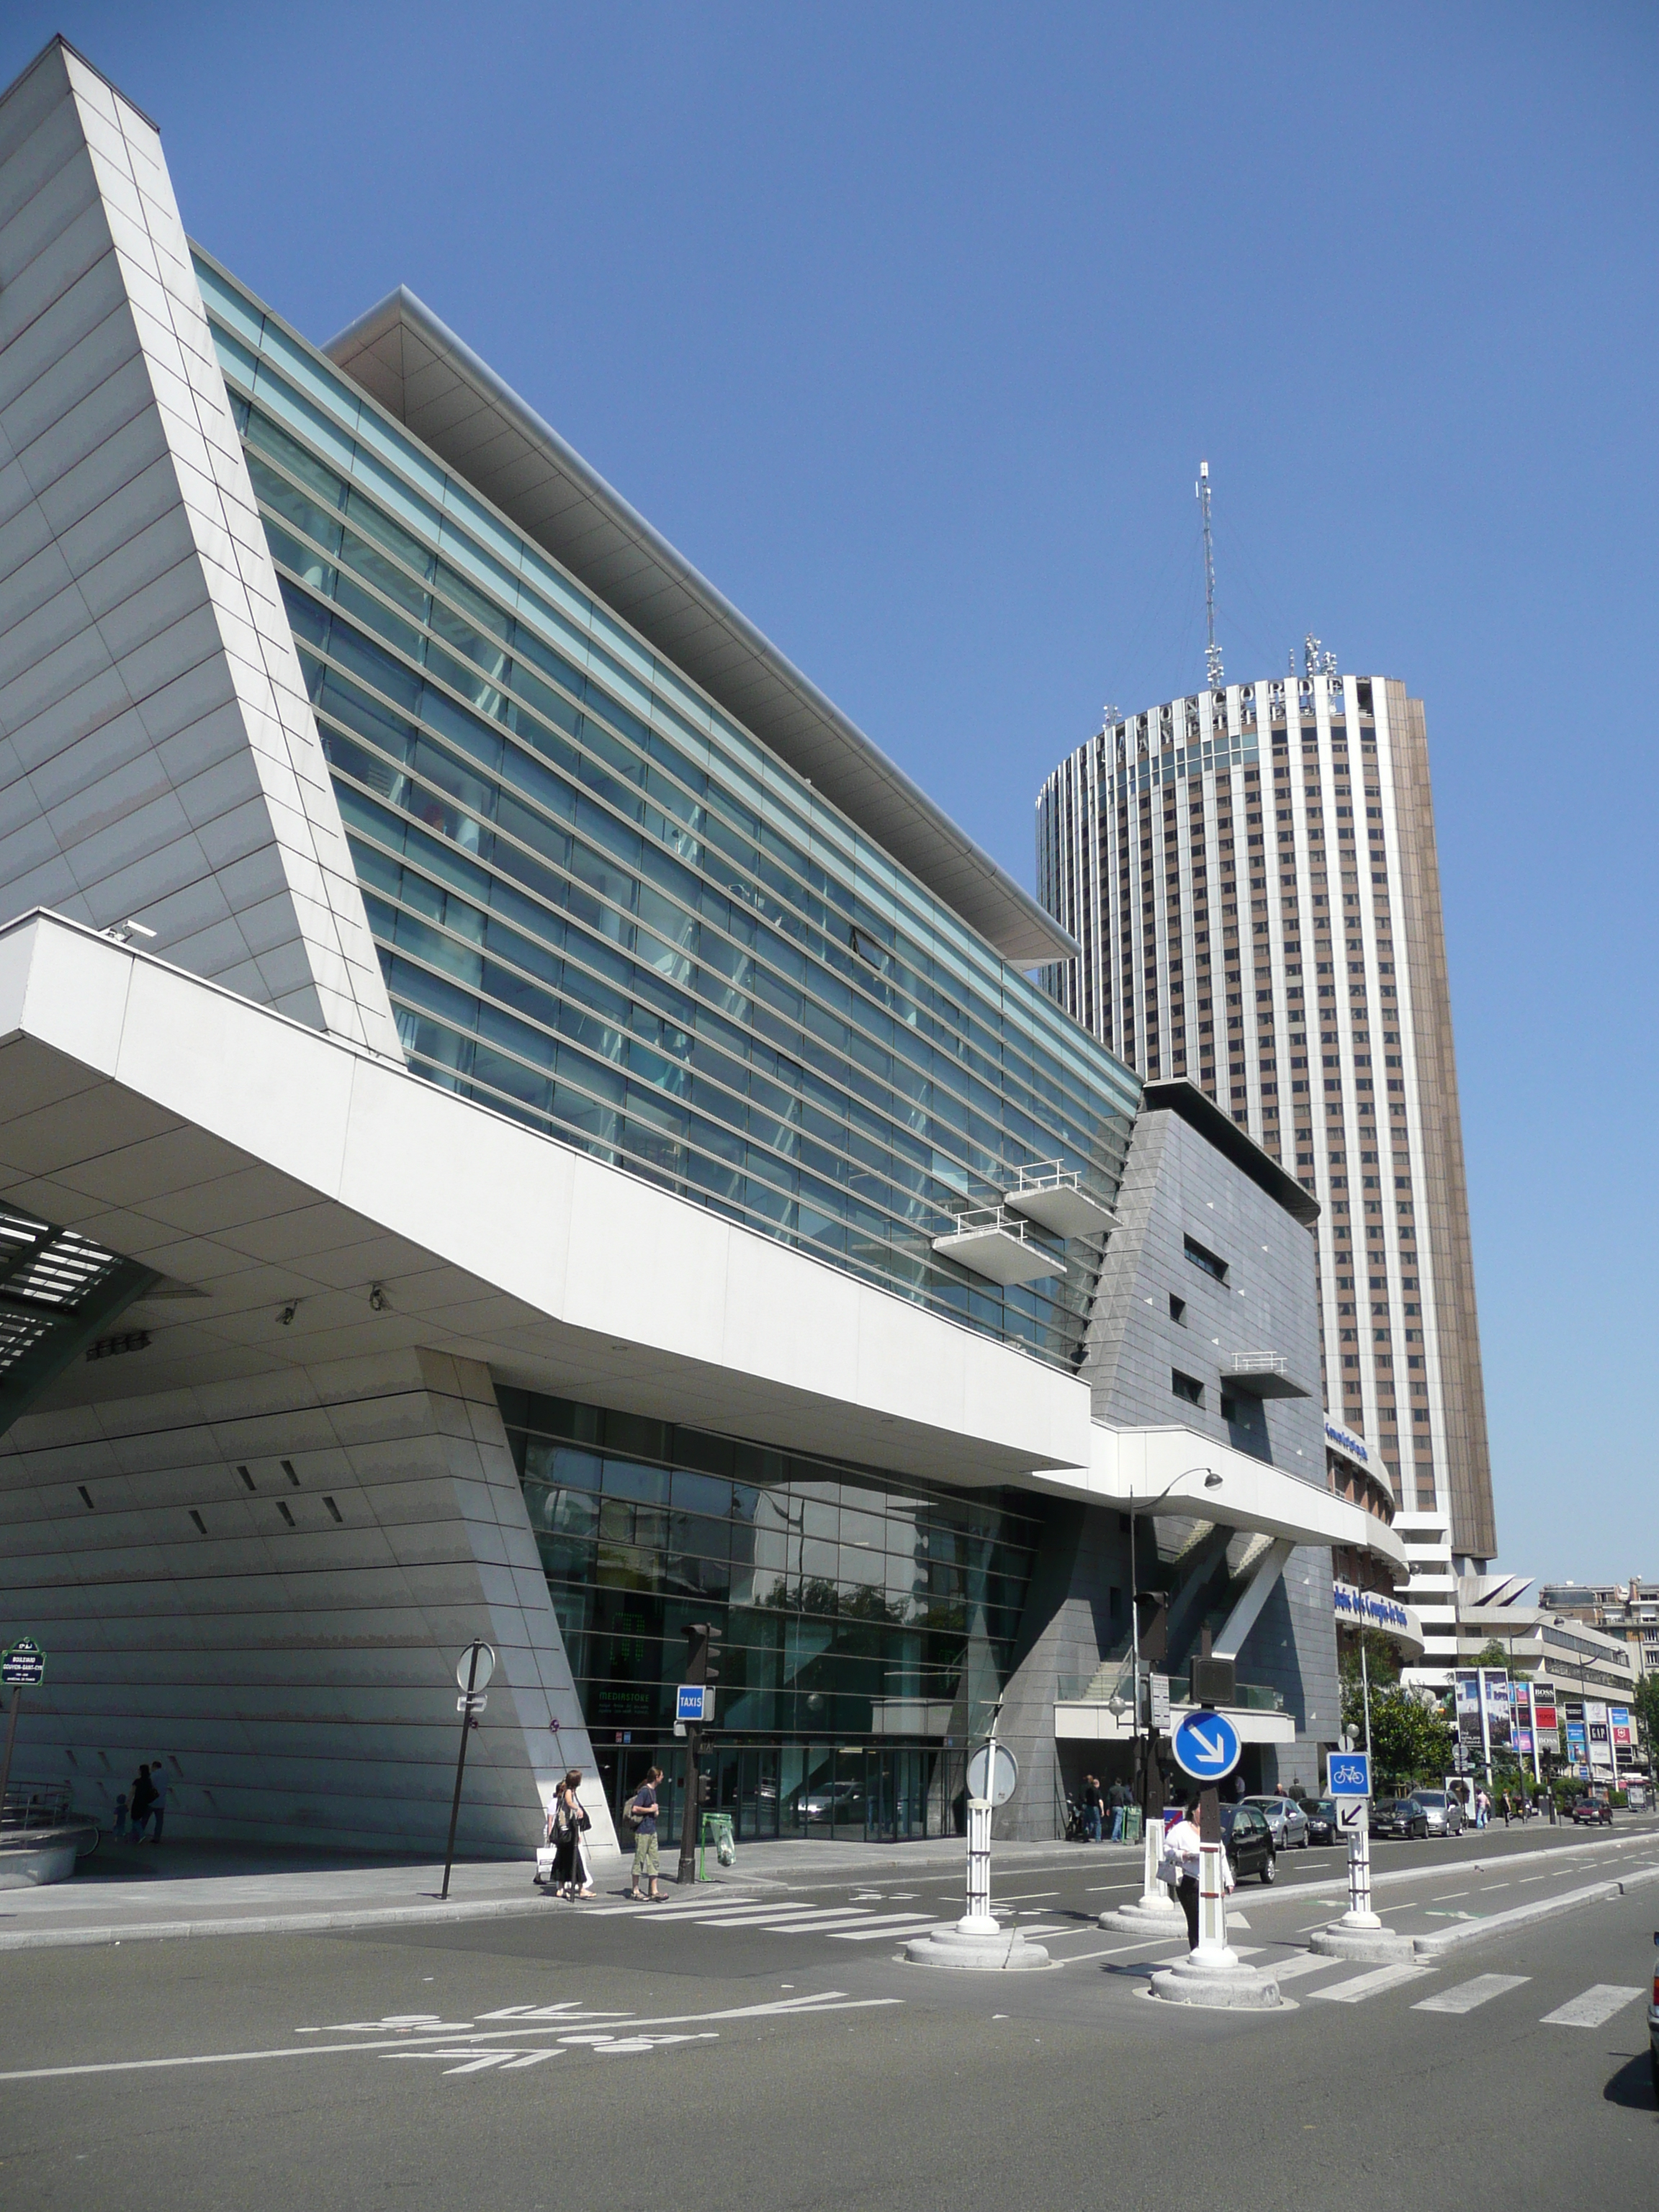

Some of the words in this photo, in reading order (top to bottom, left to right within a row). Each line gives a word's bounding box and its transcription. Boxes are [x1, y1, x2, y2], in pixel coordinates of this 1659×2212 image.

[1136, 678, 1342, 731] CONCORDE
[680, 1696, 702, 1707] TAXIS
[1591, 1728, 1606, 1739] GAP
